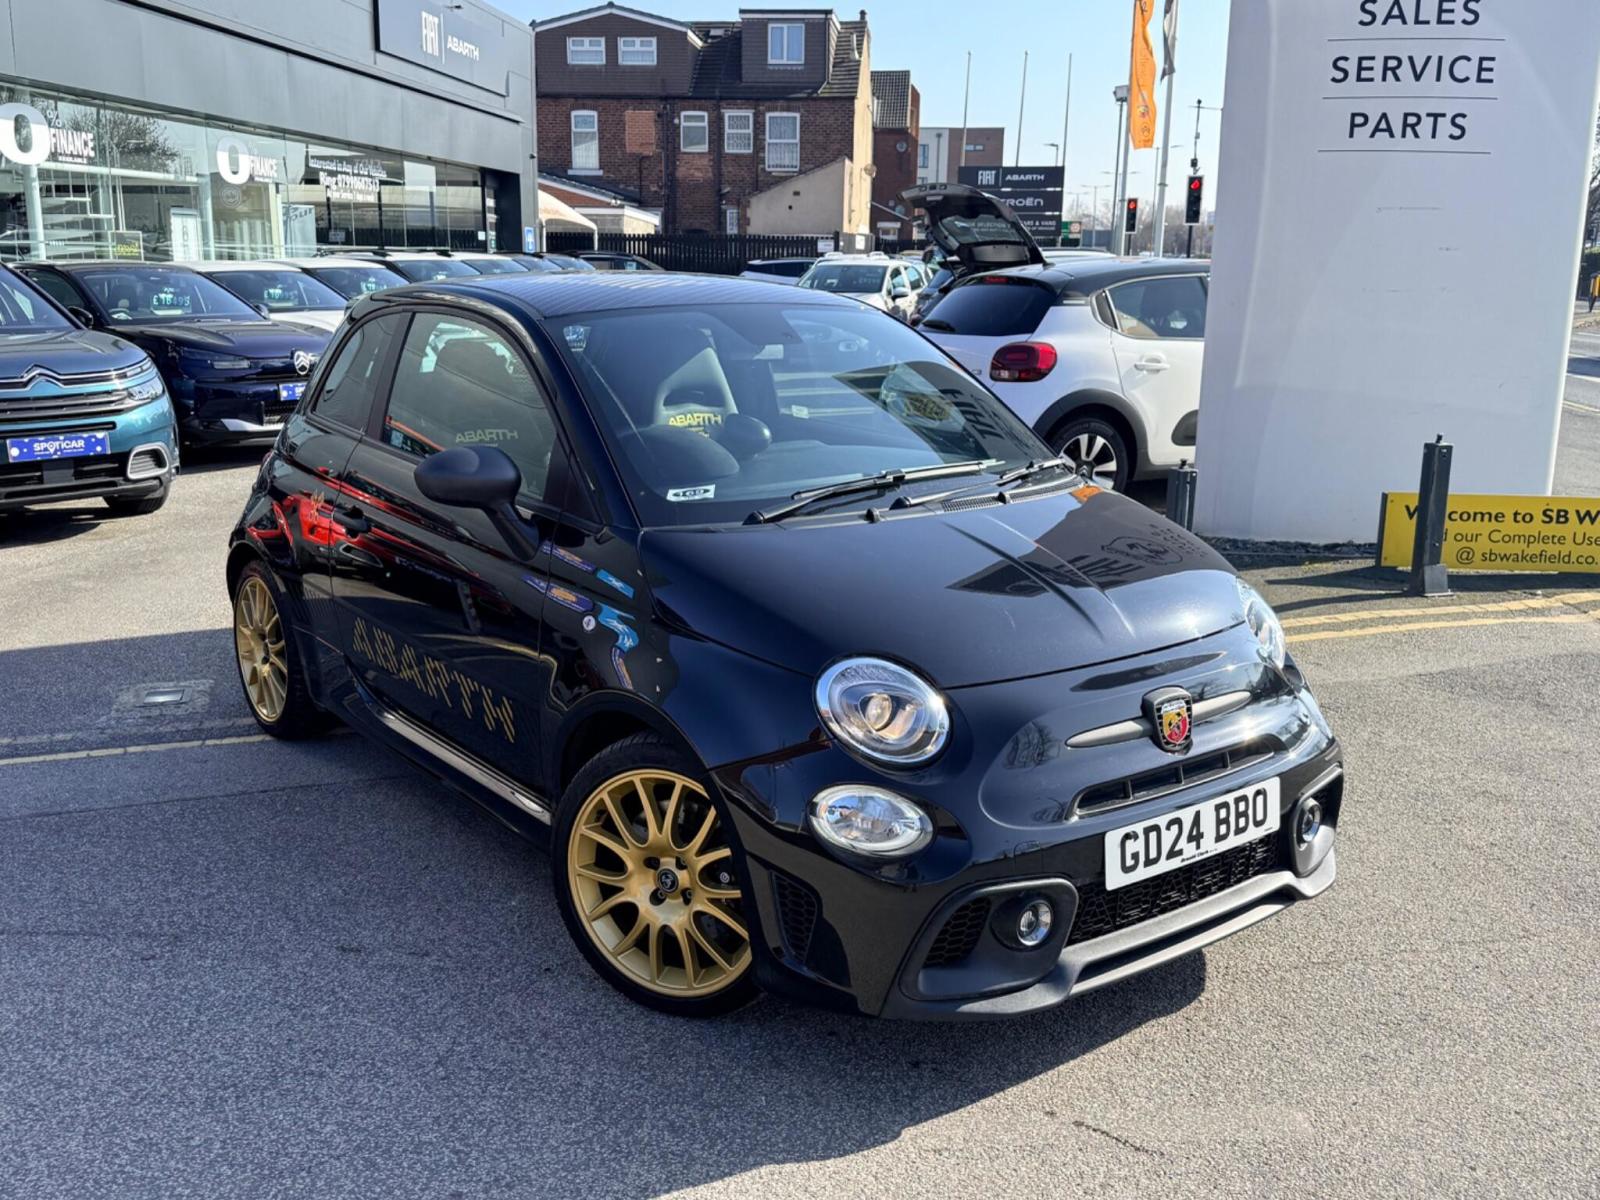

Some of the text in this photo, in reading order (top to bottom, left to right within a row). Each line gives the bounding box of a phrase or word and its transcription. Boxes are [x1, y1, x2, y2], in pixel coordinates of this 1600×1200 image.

[1358, 0, 1481, 26] SALES
[421, 11, 480, 61] FIAT ABARTH
[1330, 55, 1496, 83] SERVICE
[1348, 112, 1468, 140] PARTS
[50, 128, 95, 157] FINANCE
[250, 155, 278, 178] FINANCE
[977, 170, 996, 185] FIAT
[1001, 197, 1044, 207] ROËN
[668, 412, 721, 427] ABARTH
[455, 428, 519, 443] ABARTH
[33, 439, 85, 454] SPOTICAR
[1405, 505, 1506, 524] Wcome
[1513, 509, 1534, 524] to
[1541, 508, 1569, 525] SB
[1453, 531, 1483, 543] our
[1488, 529, 1569, 548] Complete
[1456, 546, 1475, 565] @
[352, 616, 516, 744] ABARTH
[1120, 787, 1268, 874] GD24 BBO
